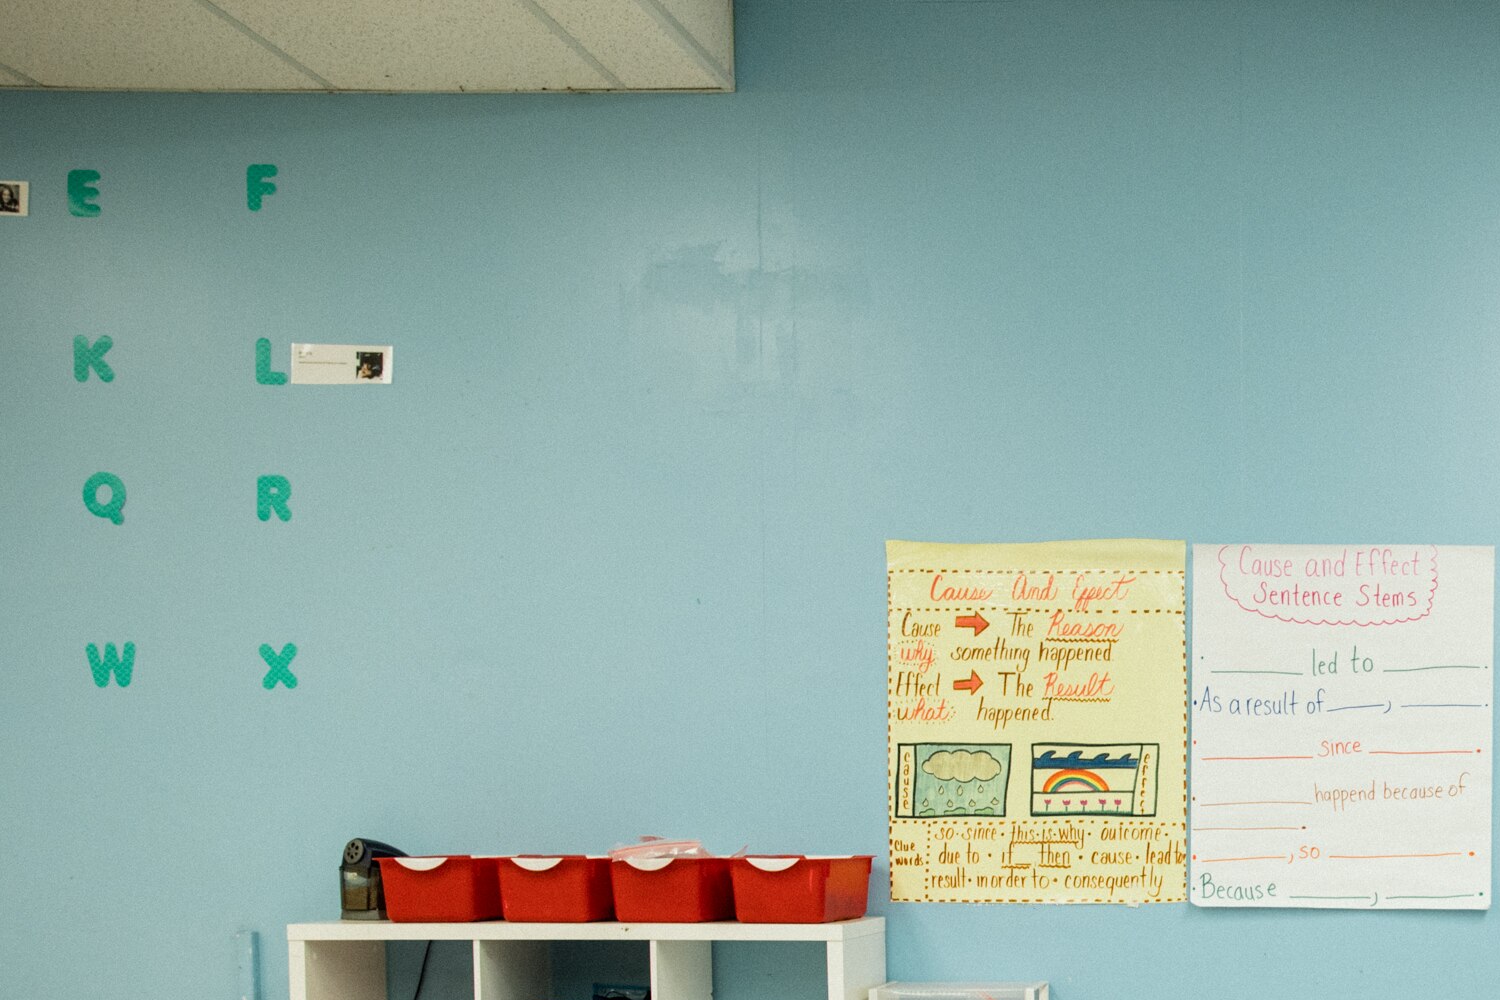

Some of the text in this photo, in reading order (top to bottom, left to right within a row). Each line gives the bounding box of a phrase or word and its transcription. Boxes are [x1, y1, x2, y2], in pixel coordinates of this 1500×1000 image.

[67, 163, 278, 217] E F
[73, 335, 288, 386] K L
[82, 471, 293, 526] Q R
[1238, 544, 1421, 577] Cause and Effect
[930, 574, 993, 602] Cause
[1071, 574, 1137, 611] Effect
[1253, 581, 1418, 607] Sentence Stems
[901, 610, 1125, 638] Cause The Reason
[85, 641, 298, 690] W X
[900, 639, 935, 673] why
[950, 636, 1031, 673] something
[1311, 645, 1374, 677] led to
[895, 671, 1116, 698] Effect The Result
[897, 698, 950, 721] what
[1199, 686, 1327, 716] As a result of
[1317, 740, 1363, 757] since
[903, 751, 911, 811] cause
[1314, 771, 1472, 812] happend because of
[894, 840, 916, 851] Clue
[1100, 824, 1162, 841] outcome
[895, 855, 925, 867] words
[938, 843, 961, 865] due
[966, 843, 980, 865] to
[1091, 849, 1132, 865] cause
[1146, 842, 1171, 865] lead
[931, 866, 967, 889] result
[1030, 867, 1050, 889] to
[1064, 864, 1165, 897] consequently
[1199, 872, 1278, 902] Because
